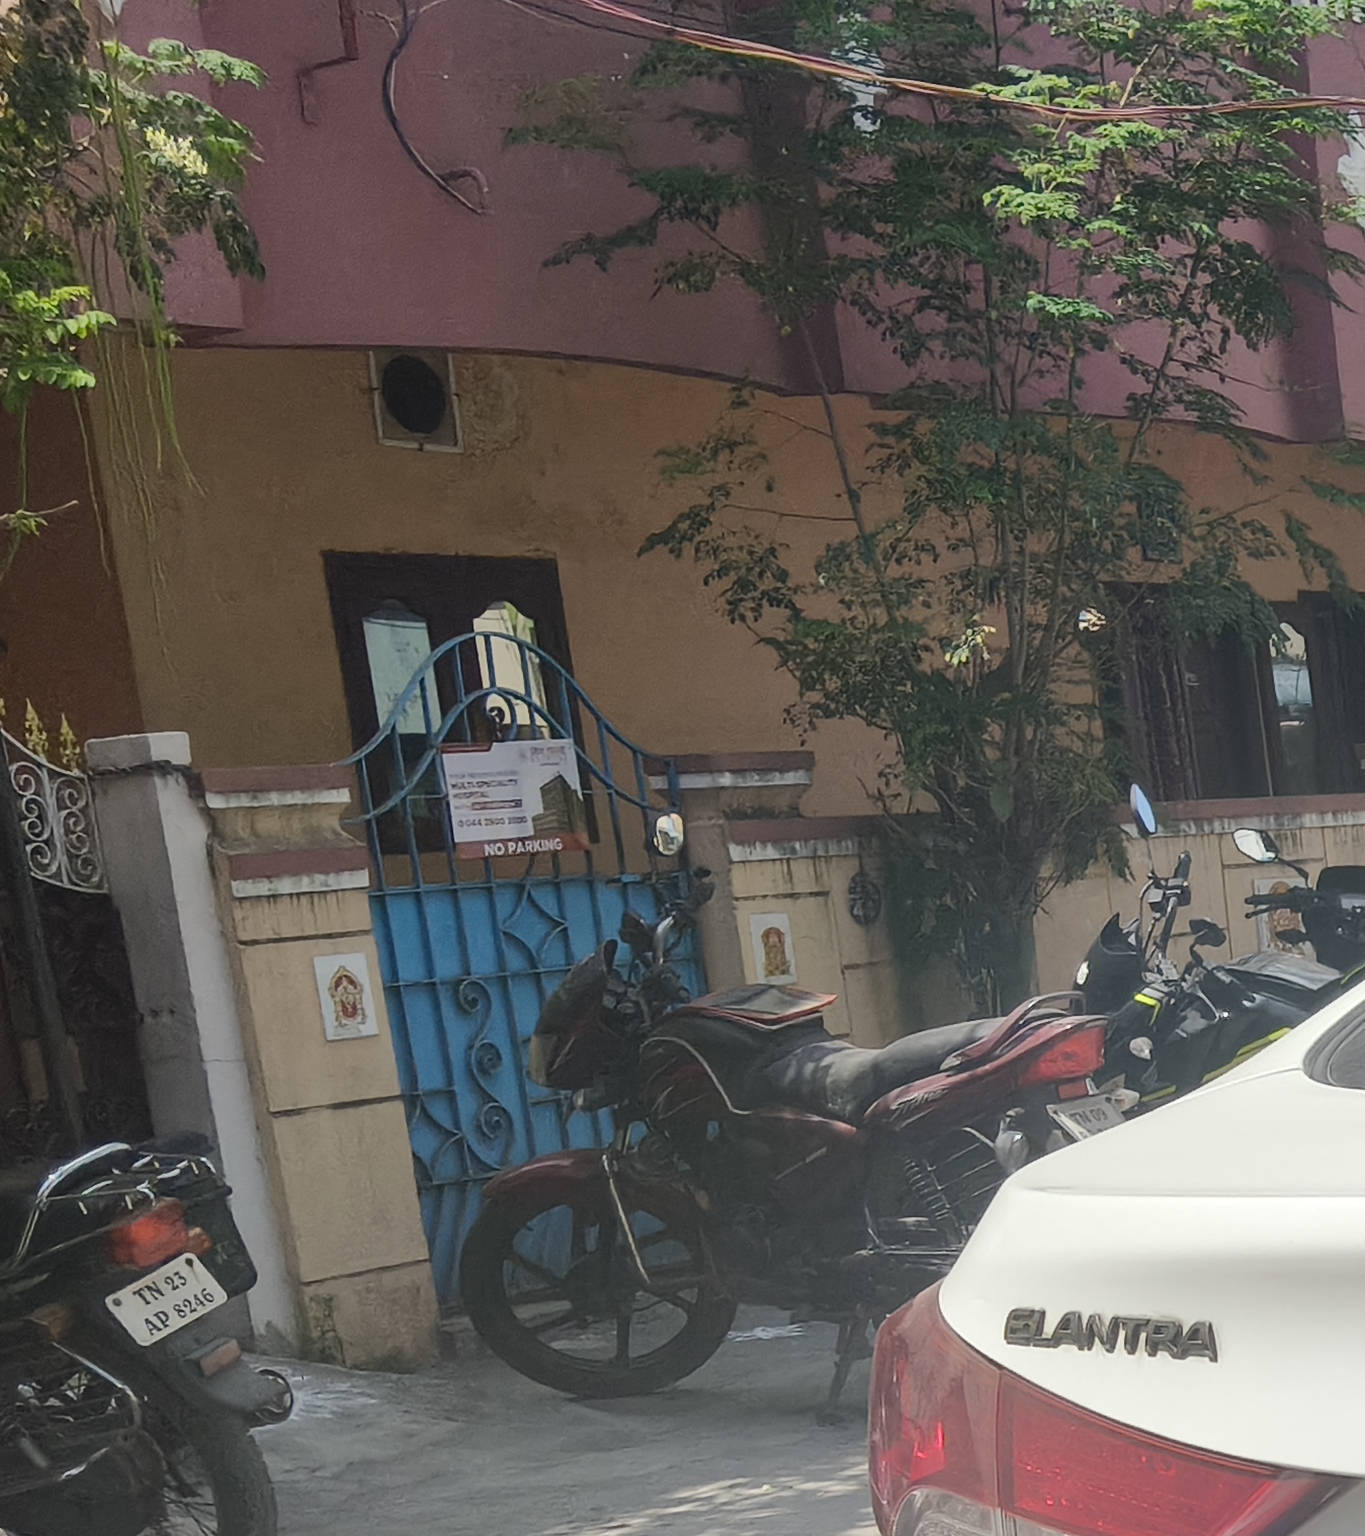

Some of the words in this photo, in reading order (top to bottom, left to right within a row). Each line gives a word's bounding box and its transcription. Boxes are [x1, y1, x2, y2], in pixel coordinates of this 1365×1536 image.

[484, 842, 505, 857] NO
[508, 837, 563, 855] PARKING
[132, 1281, 165, 1306] TN
[164, 1271, 188, 1291] 23
[143, 1310, 170, 1336] AP
[173, 1287, 215, 1320] 8246
[1004, 1307, 1218, 1363] ELANTRA
